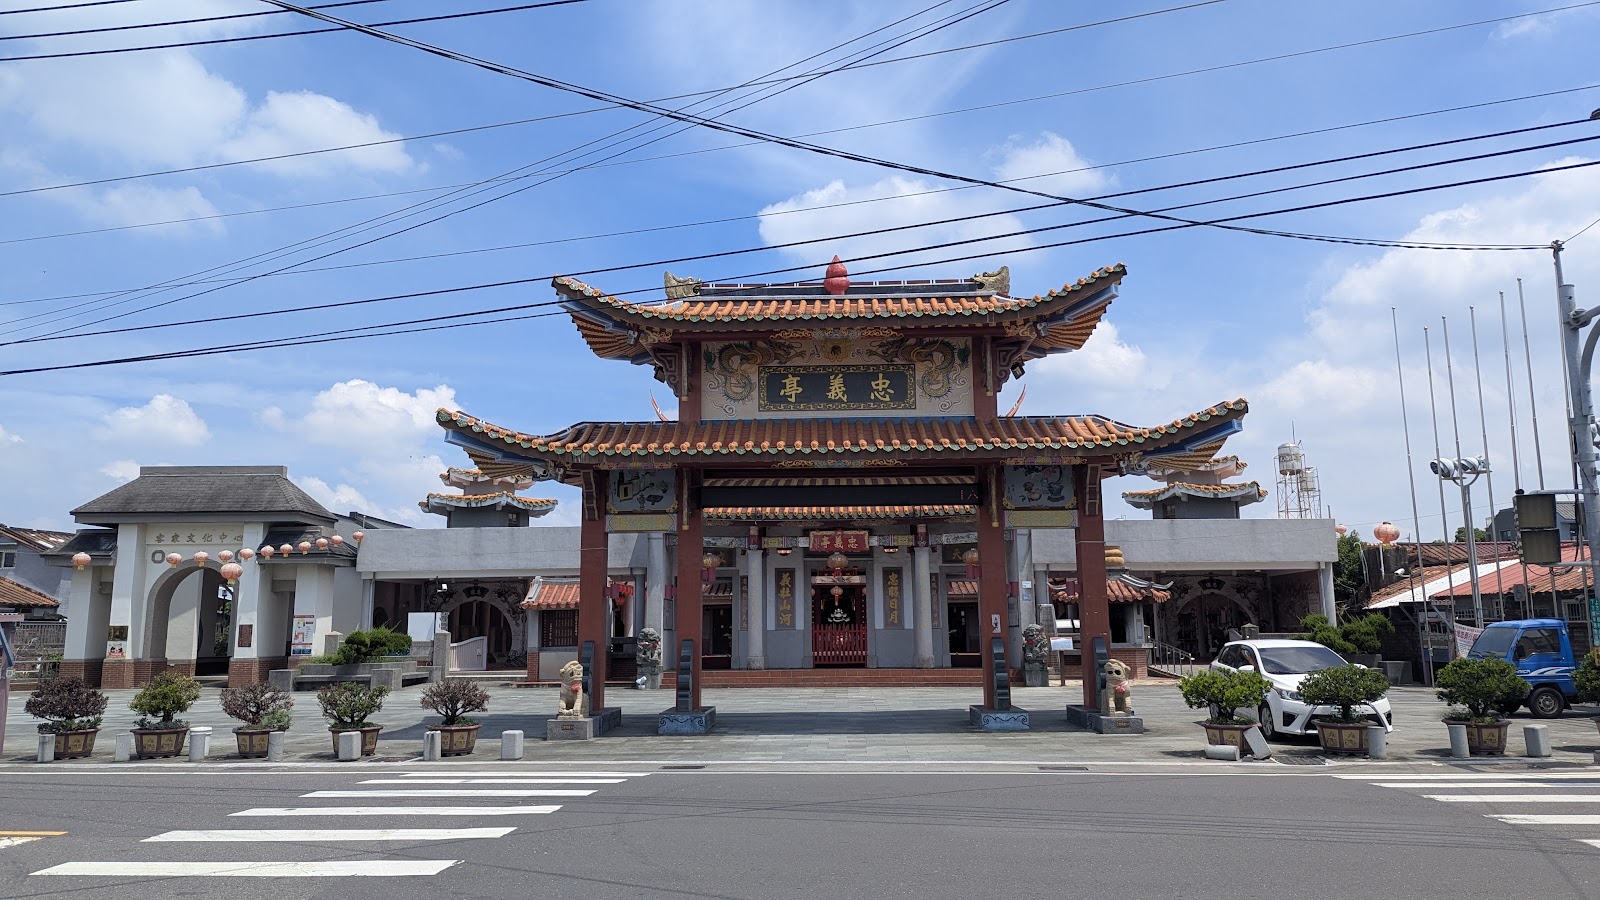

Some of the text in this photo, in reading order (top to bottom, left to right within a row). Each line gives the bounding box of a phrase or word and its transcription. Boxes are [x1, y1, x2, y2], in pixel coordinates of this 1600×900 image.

[155, 532, 243, 543] 客家文化中心
